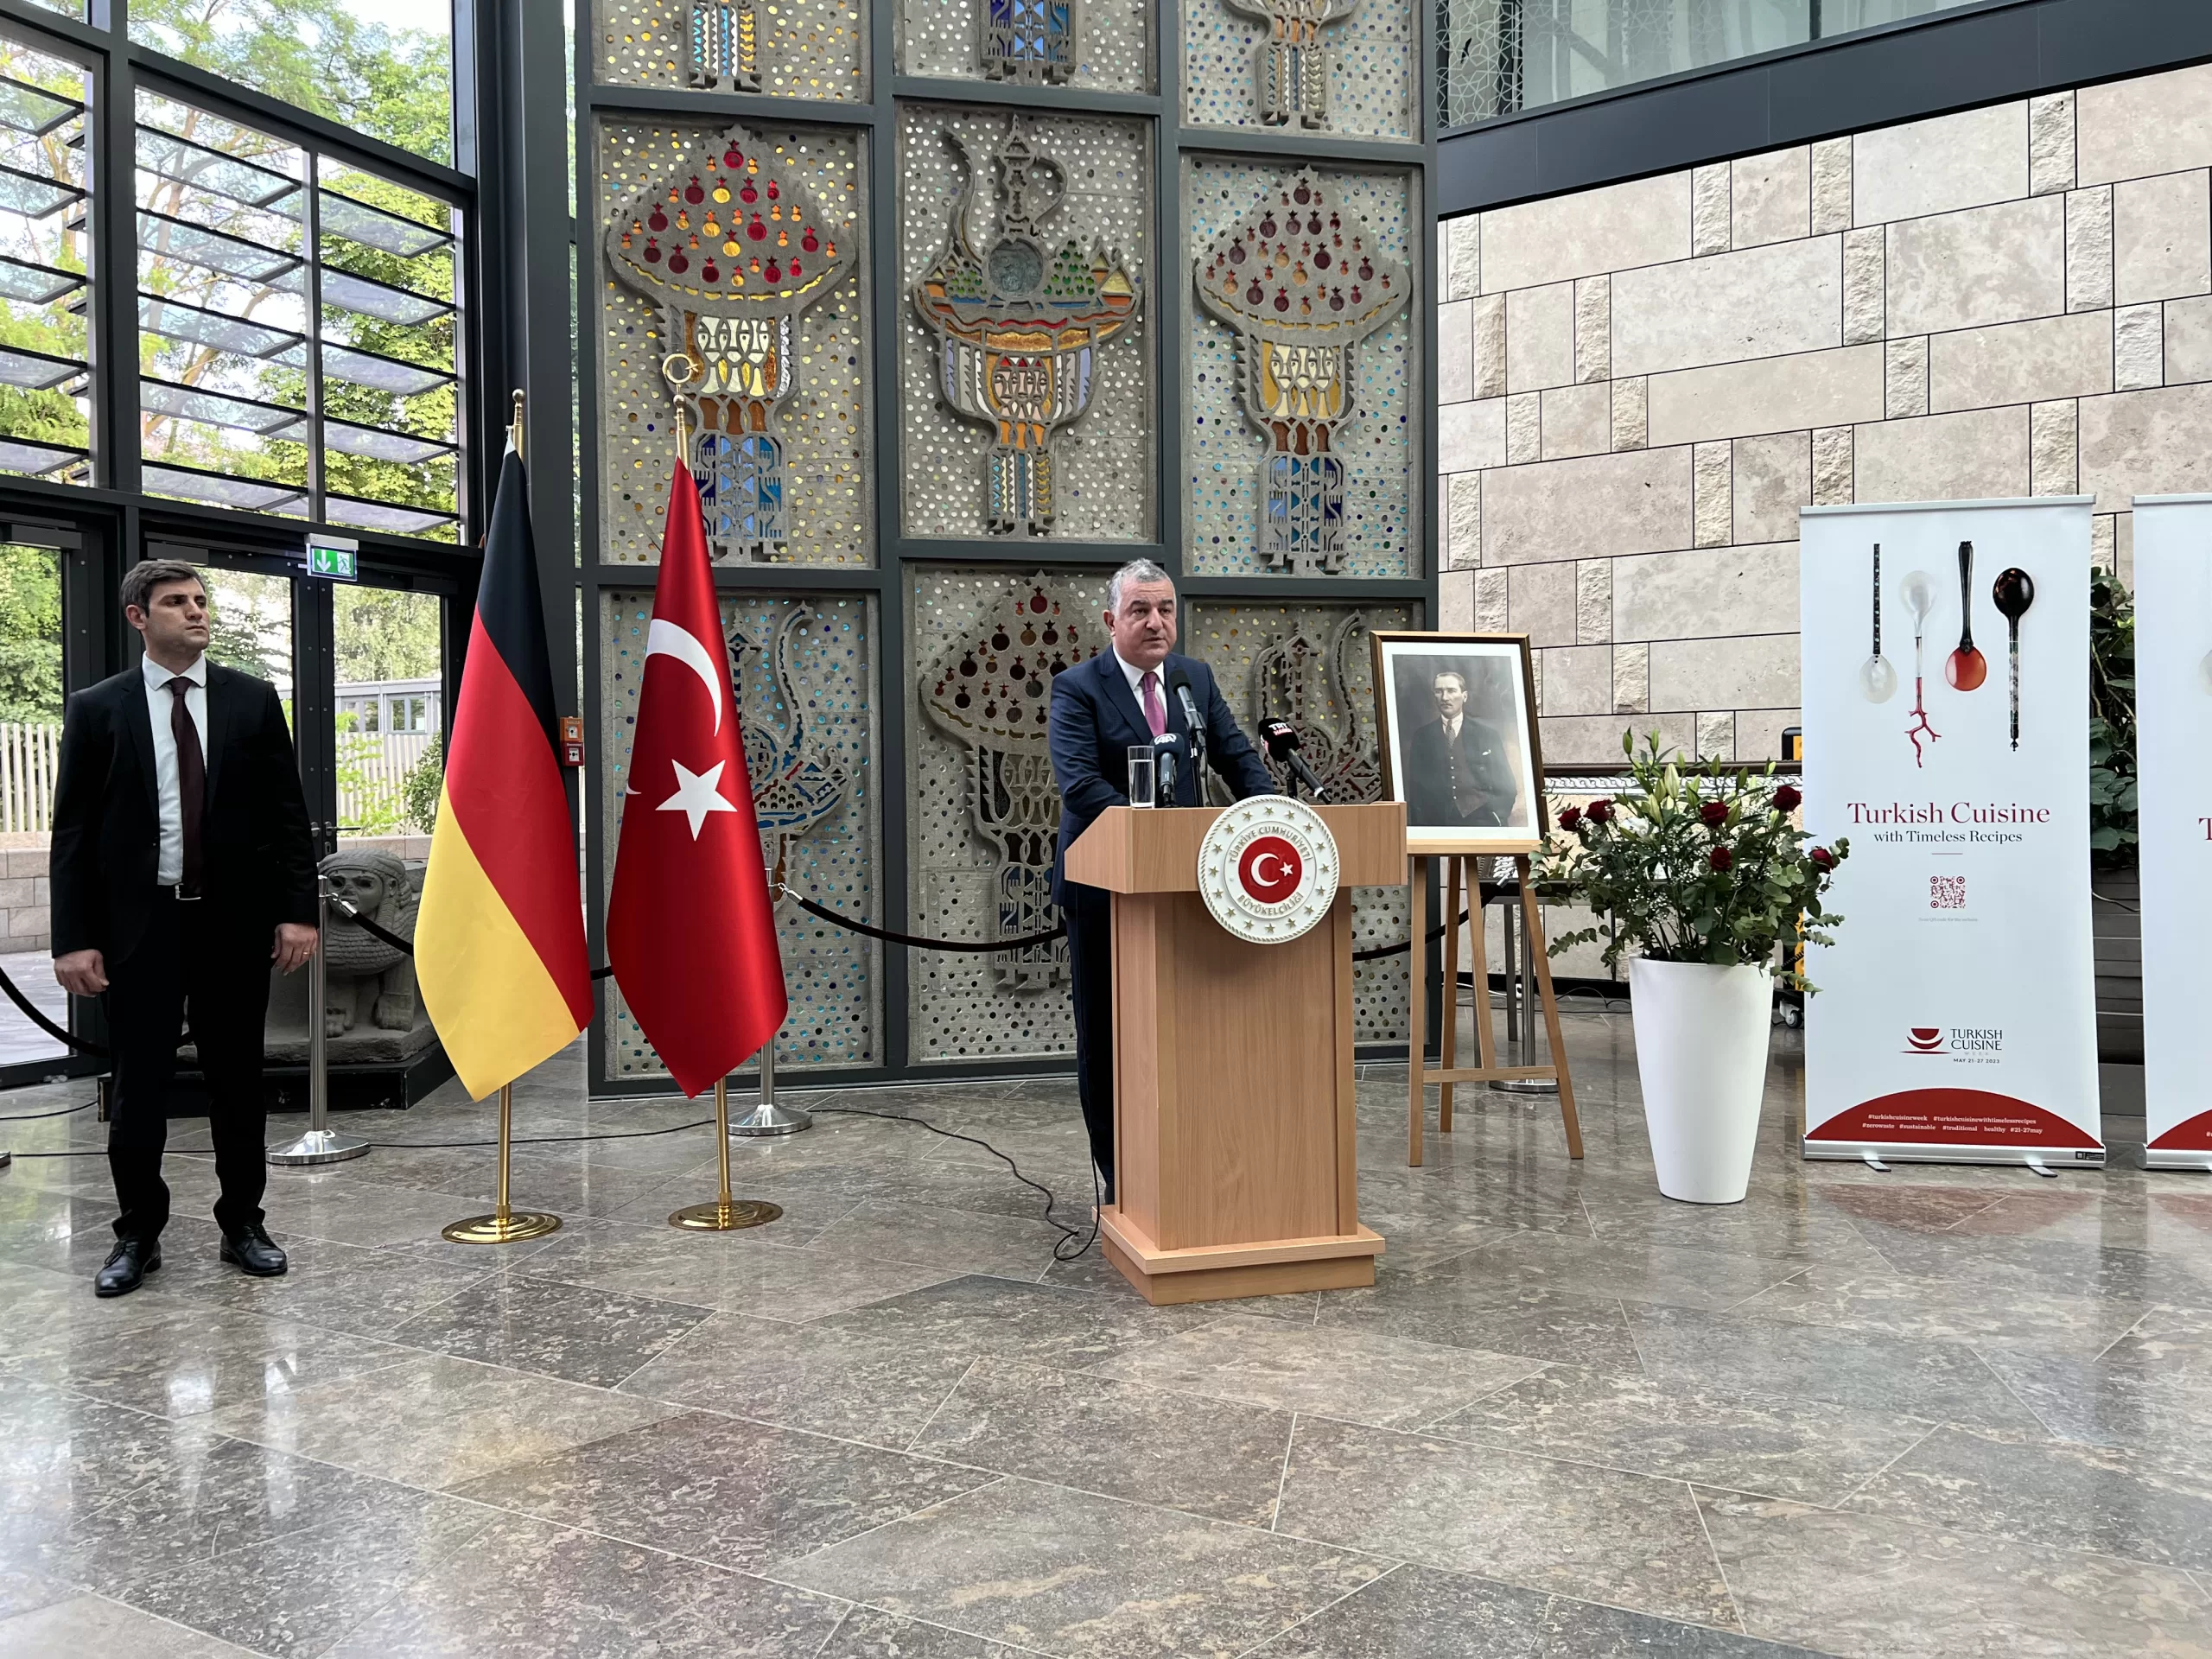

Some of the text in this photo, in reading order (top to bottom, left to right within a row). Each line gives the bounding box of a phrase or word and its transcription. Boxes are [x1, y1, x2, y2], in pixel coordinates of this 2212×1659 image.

[1847, 802, 2050, 823] Turkish Cuisine
[1230, 826, 1313, 862] TÜRKİYE CUMHURİYETİ
[1873, 830, 2023, 845] with Timeless Recipes
[1950, 1028, 2003, 1039] TURKISH
[1950, 1039, 2003, 1051] CUISINE
